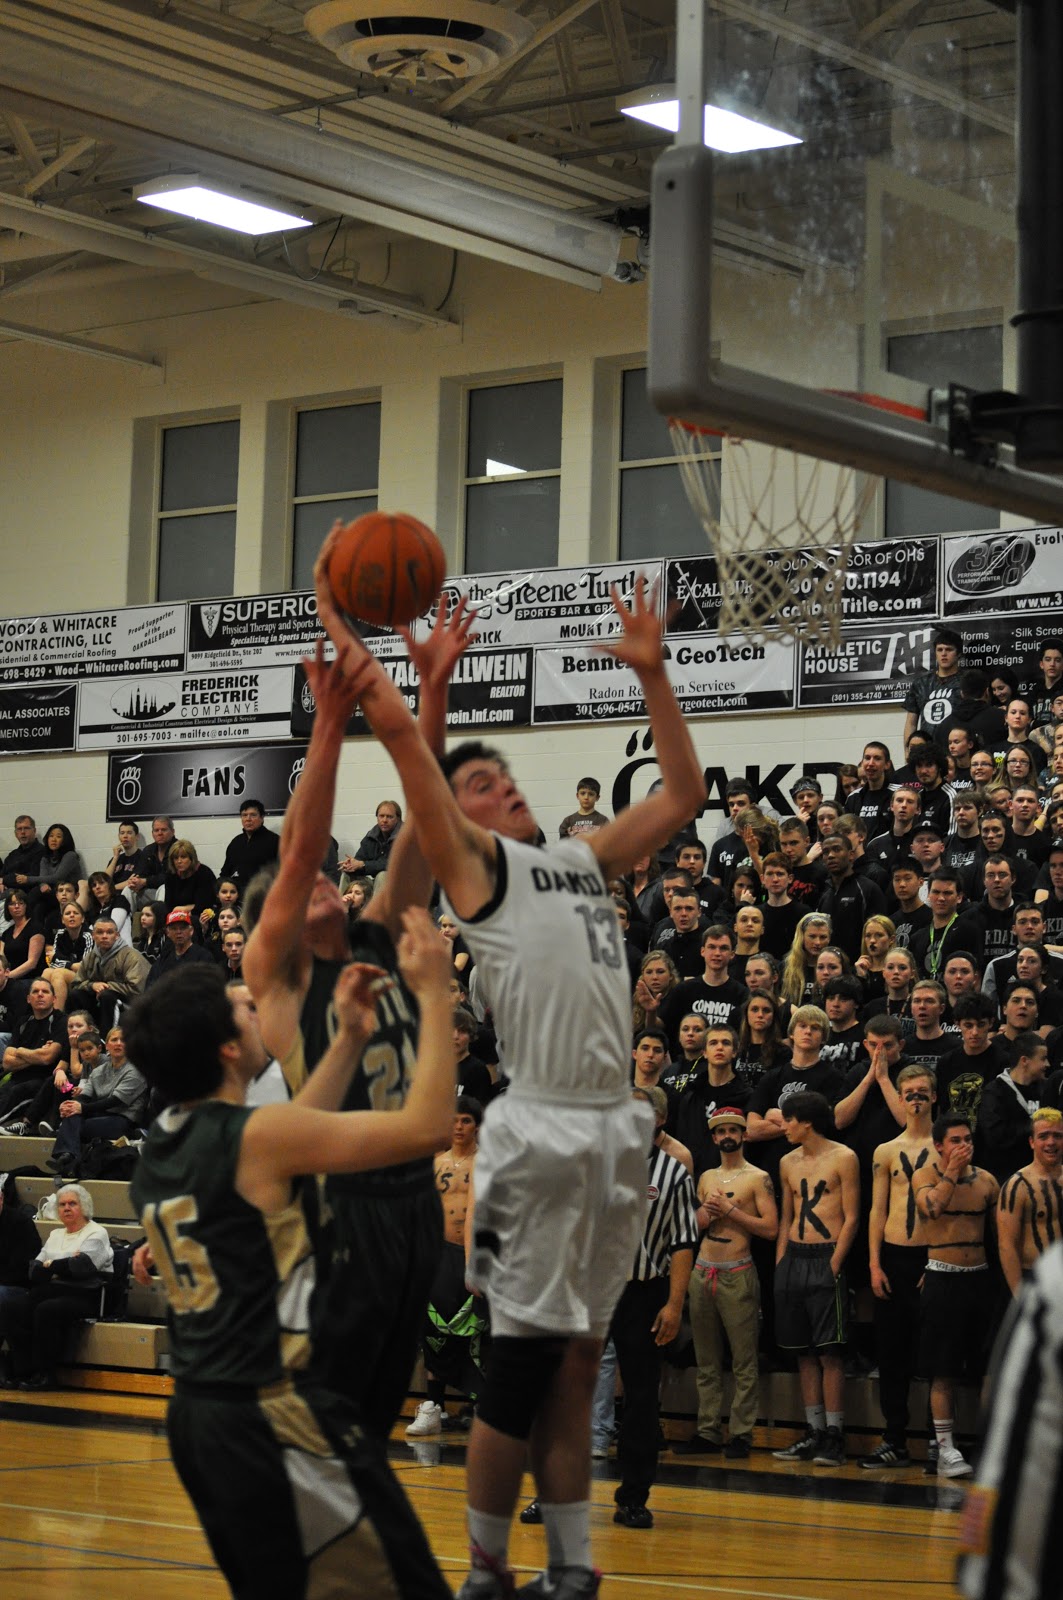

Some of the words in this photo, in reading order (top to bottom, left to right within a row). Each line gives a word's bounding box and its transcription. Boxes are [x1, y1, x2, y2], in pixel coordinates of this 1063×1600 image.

[1035, 532, 1063, 546] Evol
[875, 552, 892, 565] OF
[894, 547, 925, 564] OHS
[469, 583, 493, 601] the
[495, 579, 578, 614] Greene
[579, 569, 650, 599] Turtle
[516, 607, 557, 619] SPORTS
[560, 605, 582, 616] BAR
[584, 605, 591, 614] &
[40, 621, 48, 634] &
[53, 616, 117, 633] WHITACRE
[128, 622, 145, 636] Proud
[146, 610, 175, 628] Supporter
[151, 626, 161, 635] the
[222, 623, 249, 637] Physical
[250, 621, 277, 633] Therapy
[278, 619, 292, 631] and
[292, 618, 315, 631] Sports
[92, 632, 112, 646] LLC
[132, 635, 158, 652] OAKDALE
[159, 626, 176, 641] BEARS
[230, 634, 269, 647] Specializing
[270, 634, 278, 643] in
[279, 632, 300, 643] Sports
[300, 630, 327, 642] Injuries
[1015, 627, 1033, 638] Silk
[33, 653, 38, 662] &
[41, 649, 85, 662] Commercial
[87, 648, 117, 658] Roofing
[676, 644, 766, 666] GeoTech
[805, 640, 882, 659] ATHLETIC
[54, 658, 179, 676] Wood-WhitacreRoofing.com
[448, 653, 527, 684] LLWEIN
[805, 657, 859, 675] HOUSE
[985, 655, 1024, 669] Designs
[182, 675, 260, 692] FREDERICK
[489, 684, 526, 699] REALTOR
[688, 680, 736, 694] Services
[875, 682, 912, 691] www.ATH
[181, 689, 259, 707] ELECTRIC
[588, 685, 624, 700] Radon
[831, 694, 849, 703] (301)
[850, 691, 882, 700] 355-4740
[890, 689, 910, 698] 1895
[14, 706, 71, 719] ASSOCIATES
[181, 703, 251, 718] COMPANY
[575, 702, 642, 716] 301-696-0547
[0, 726, 52, 739] MENTS.COM
[116, 731, 172, 744] 301-695-7003
[179, 727, 250, 740] mailfec@aol.com
[181, 765, 246, 799] FANS
[574, 904, 622, 970] 13
[798, 1177, 832, 1241] K
